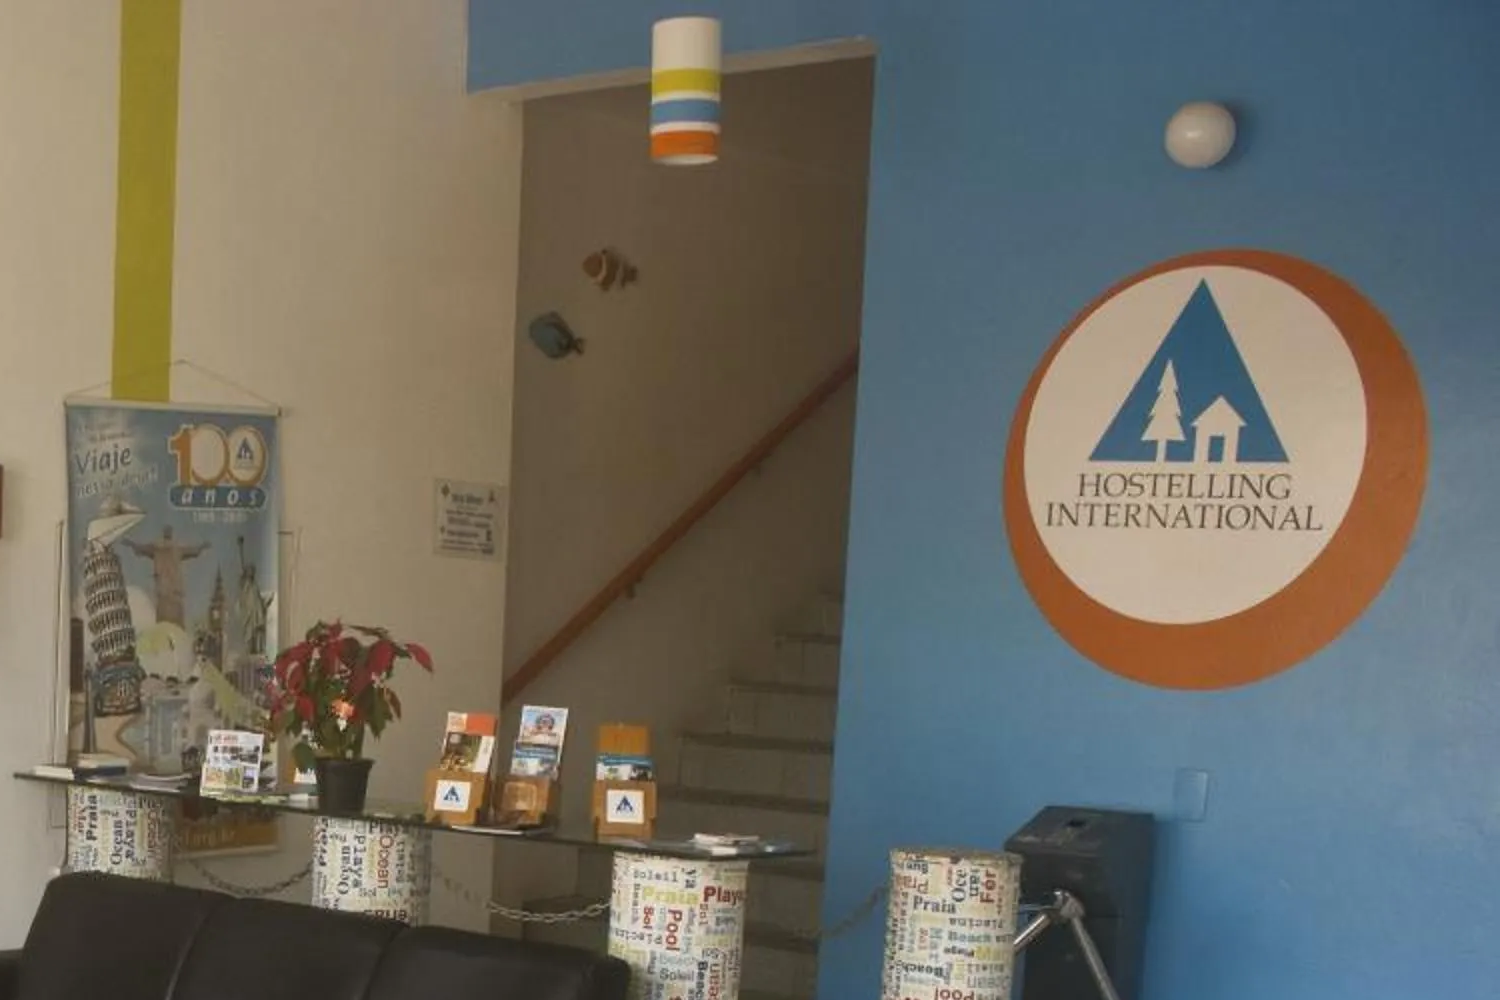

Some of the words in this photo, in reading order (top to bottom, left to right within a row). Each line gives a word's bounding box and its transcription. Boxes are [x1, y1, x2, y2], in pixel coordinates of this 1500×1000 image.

[74, 443, 132, 477] Viaje
[168, 424, 268, 486] 100
[181, 488, 259, 506] anos
[1077, 472, 1292, 500] HOSTELLING
[1045, 502, 1324, 532] INTERNATIONAL
[86, 795, 97, 840] Praia
[110, 820, 122, 865] Ocean
[350, 834, 366, 888] Playa
[377, 836, 394, 889] Ocean
[337, 845, 351, 895] Ocean
[951, 869, 967, 903] Oce
[913, 895, 957, 914] Praia
[665, 908, 683, 951] Pool
